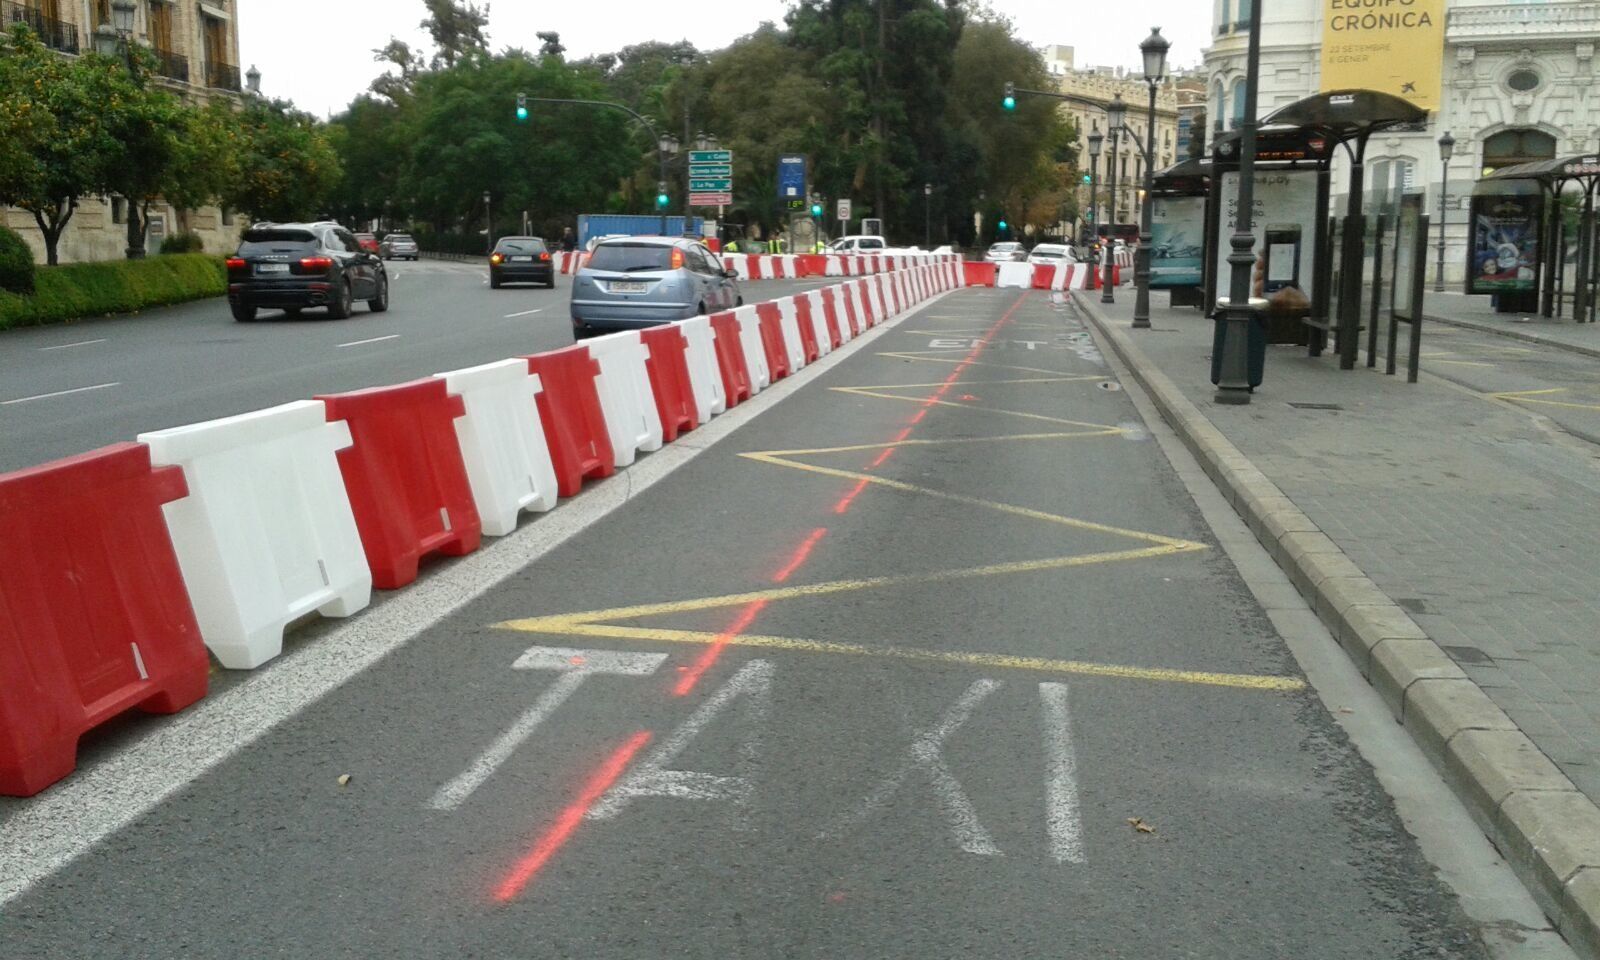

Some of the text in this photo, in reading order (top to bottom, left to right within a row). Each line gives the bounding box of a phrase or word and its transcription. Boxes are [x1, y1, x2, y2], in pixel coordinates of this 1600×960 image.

[1331, 10, 1432, 31] CRÓNICA
[1342, 43, 1391, 53] SETEMBRE
[1336, 54, 1369, 63] GENER
[425, 645, 1087, 863] TAXI
